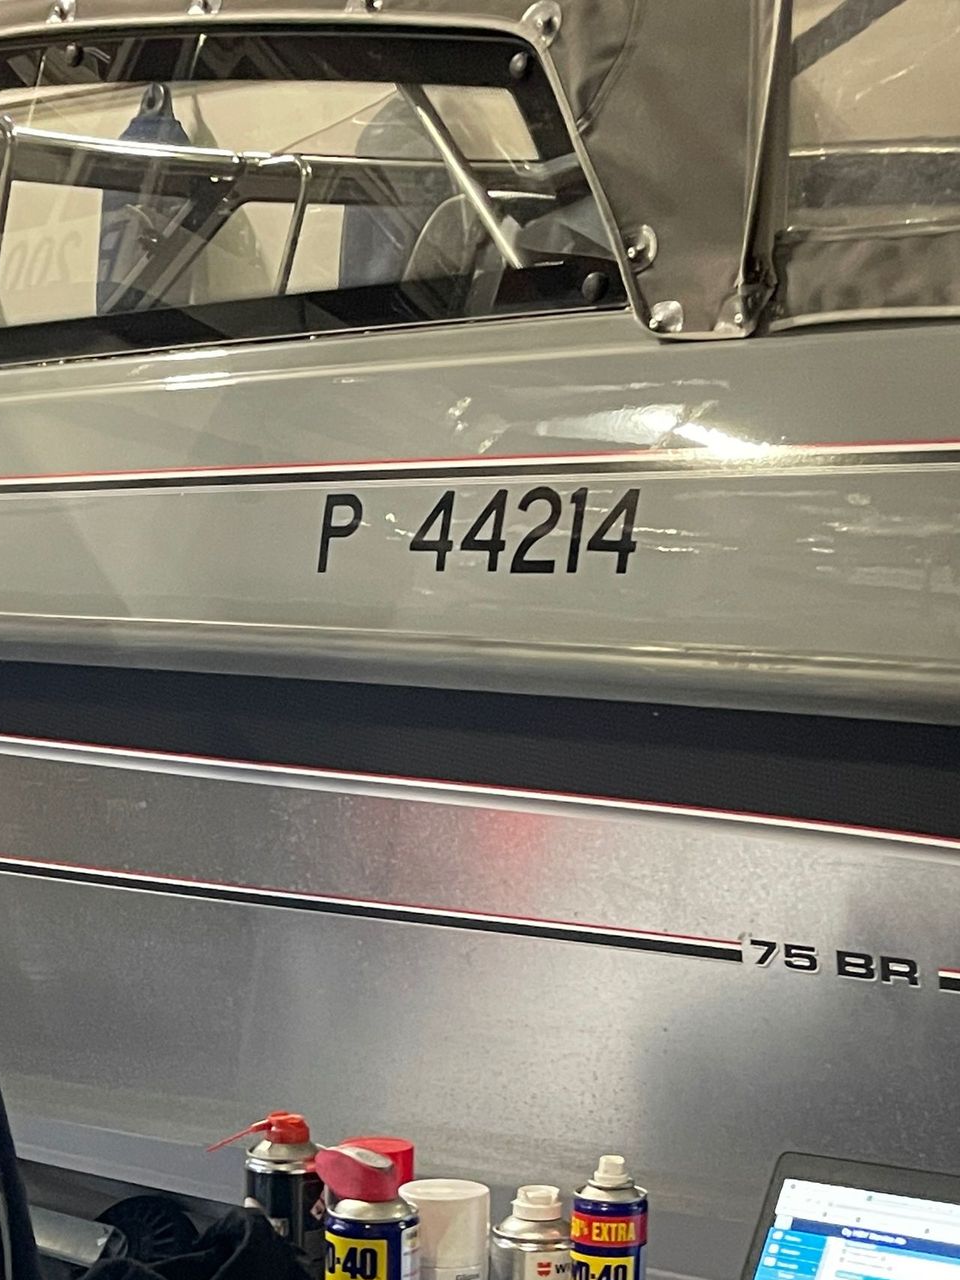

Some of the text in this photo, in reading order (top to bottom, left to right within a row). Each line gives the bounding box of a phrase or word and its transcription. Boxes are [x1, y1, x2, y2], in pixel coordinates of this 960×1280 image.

[317, 486, 640, 574] P 44214
[750, 939, 921, 988] 75 BR
[592, 1222, 636, 1241] EXTRA
[325, 1239, 378, 1280] D-40
